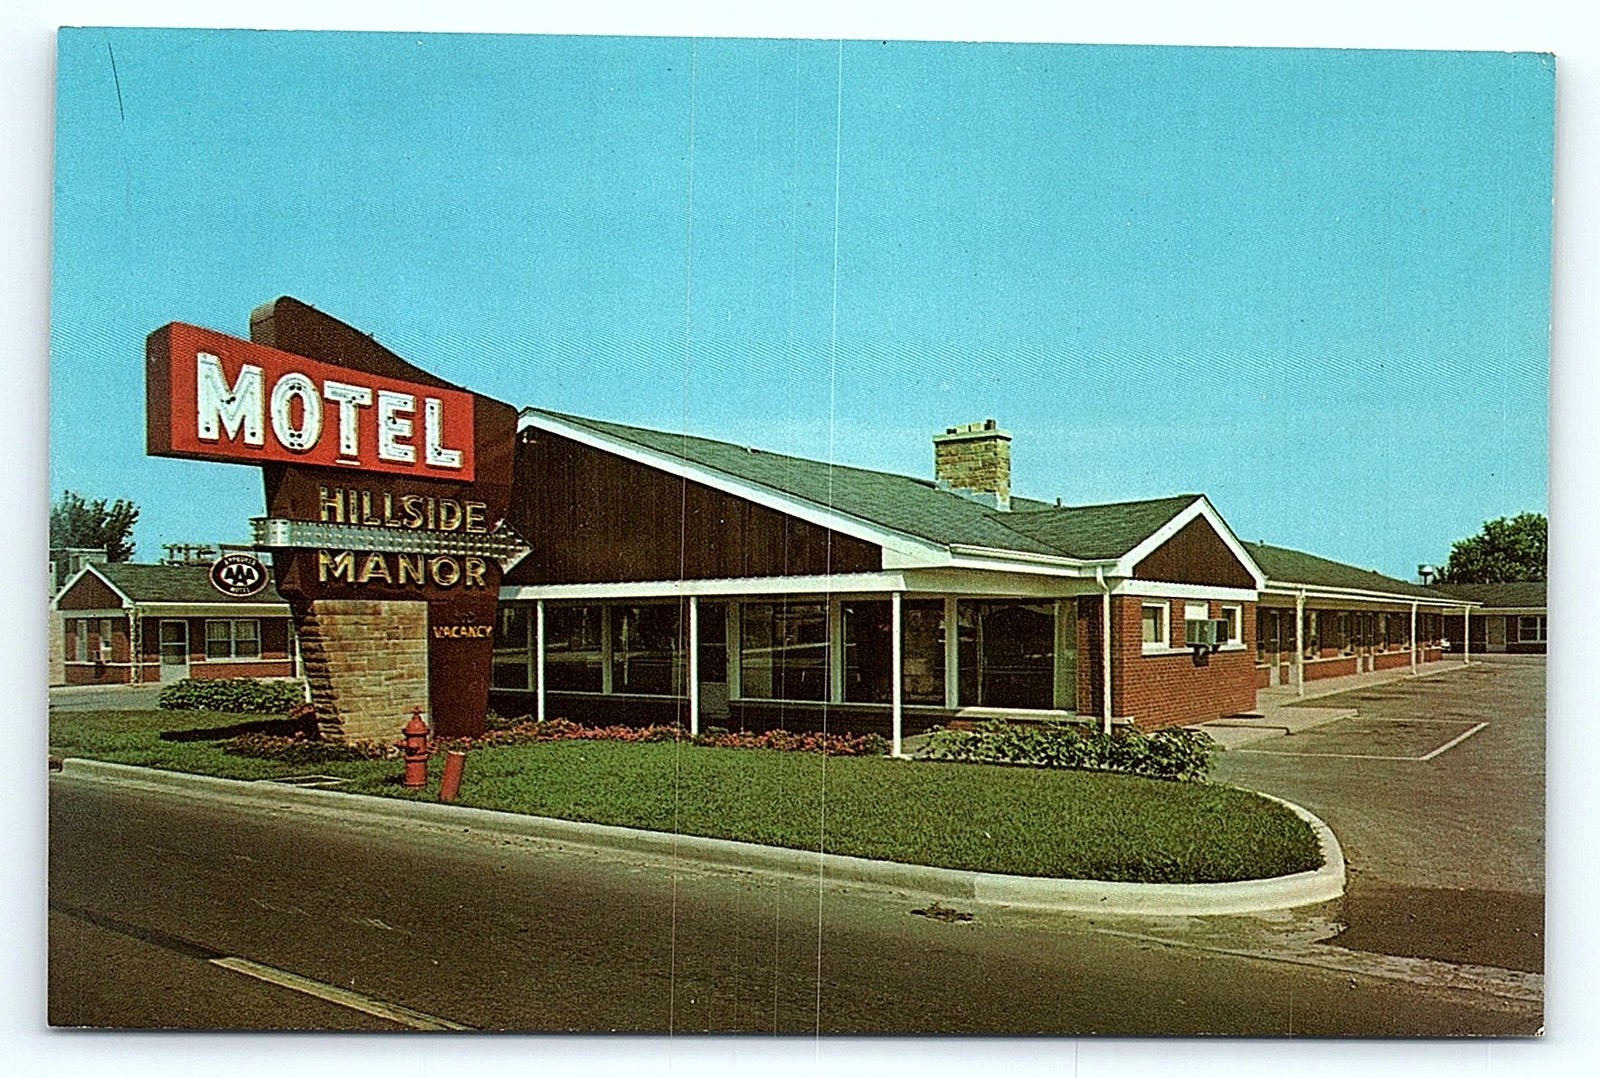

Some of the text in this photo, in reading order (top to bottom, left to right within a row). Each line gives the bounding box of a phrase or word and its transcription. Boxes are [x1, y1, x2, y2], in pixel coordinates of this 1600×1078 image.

[197, 352, 464, 468] MOTEL
[319, 485, 488, 534] HILLSIDE
[224, 565, 255, 586] AAA
[318, 550, 488, 587] MANOR
[432, 625, 493, 638] VACANCY
